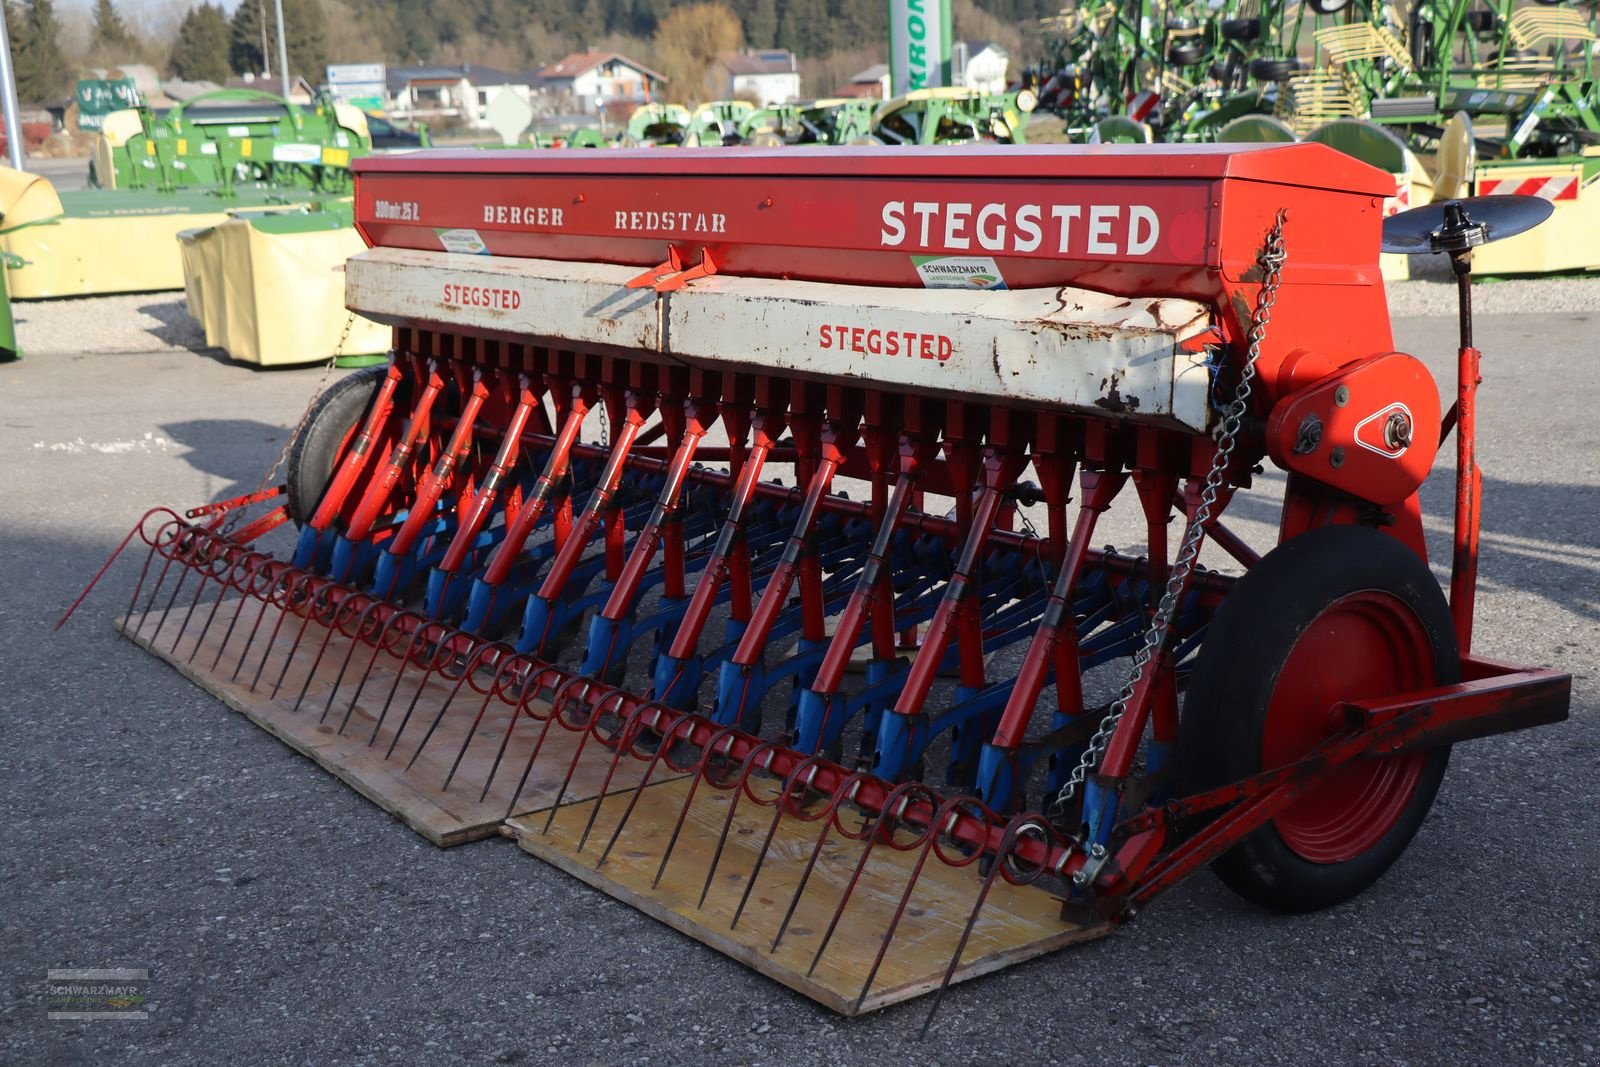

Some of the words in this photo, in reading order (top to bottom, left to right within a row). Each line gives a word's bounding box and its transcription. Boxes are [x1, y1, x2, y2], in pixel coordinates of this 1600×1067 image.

[483, 205, 564, 226] BERGER
[615, 211, 726, 233] REDSTAR
[880, 200, 1160, 256] STEGSTED
[922, 265, 988, 274] SCHWARZMAYR
[444, 284, 521, 309] STEGSTED
[819, 324, 953, 361] STEGSTED
